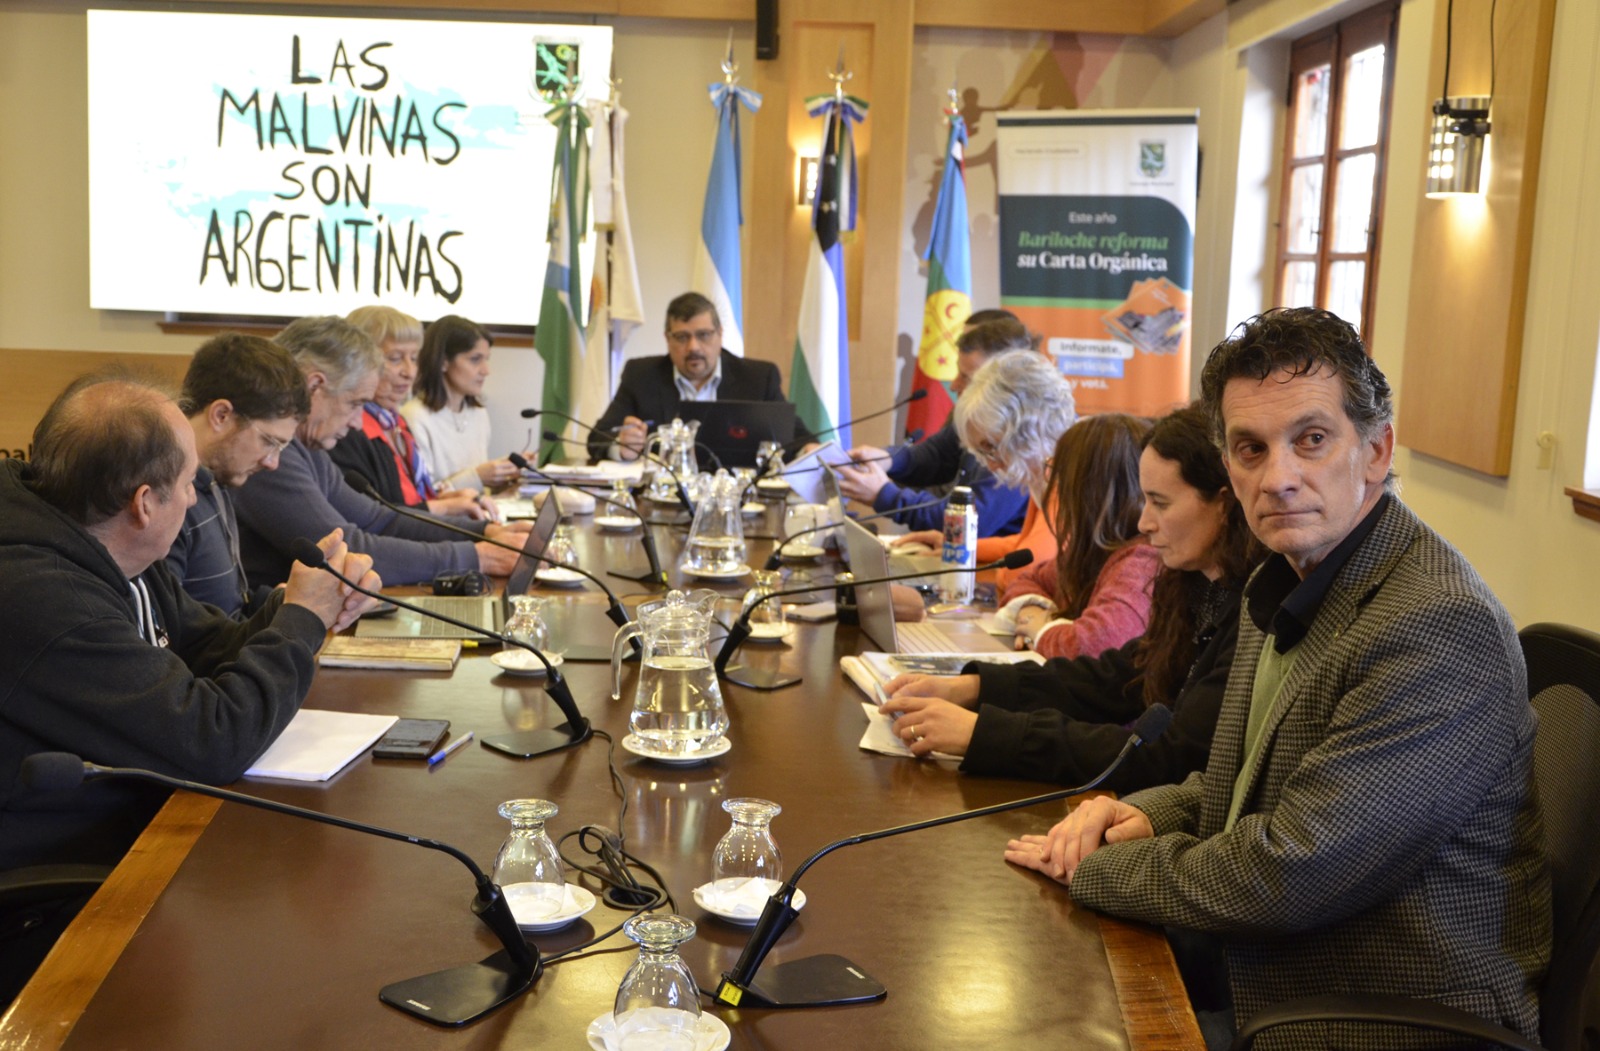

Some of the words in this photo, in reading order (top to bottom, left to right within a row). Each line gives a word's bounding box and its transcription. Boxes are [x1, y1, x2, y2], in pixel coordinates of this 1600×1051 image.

[291, 35, 393, 91] LAS
[218, 88, 467, 165] MALVINAS
[275, 161, 371, 209] SON
[1068, 211, 1093, 224] Este
[1094, 212, 1117, 224] año
[1018, 230, 1097, 249] Bariloche
[1100, 231, 1169, 253] reforma
[1017, 253, 1037, 268] su
[1038, 251, 1087, 269] Carta
[1088, 251, 1169, 275] Orgánica
